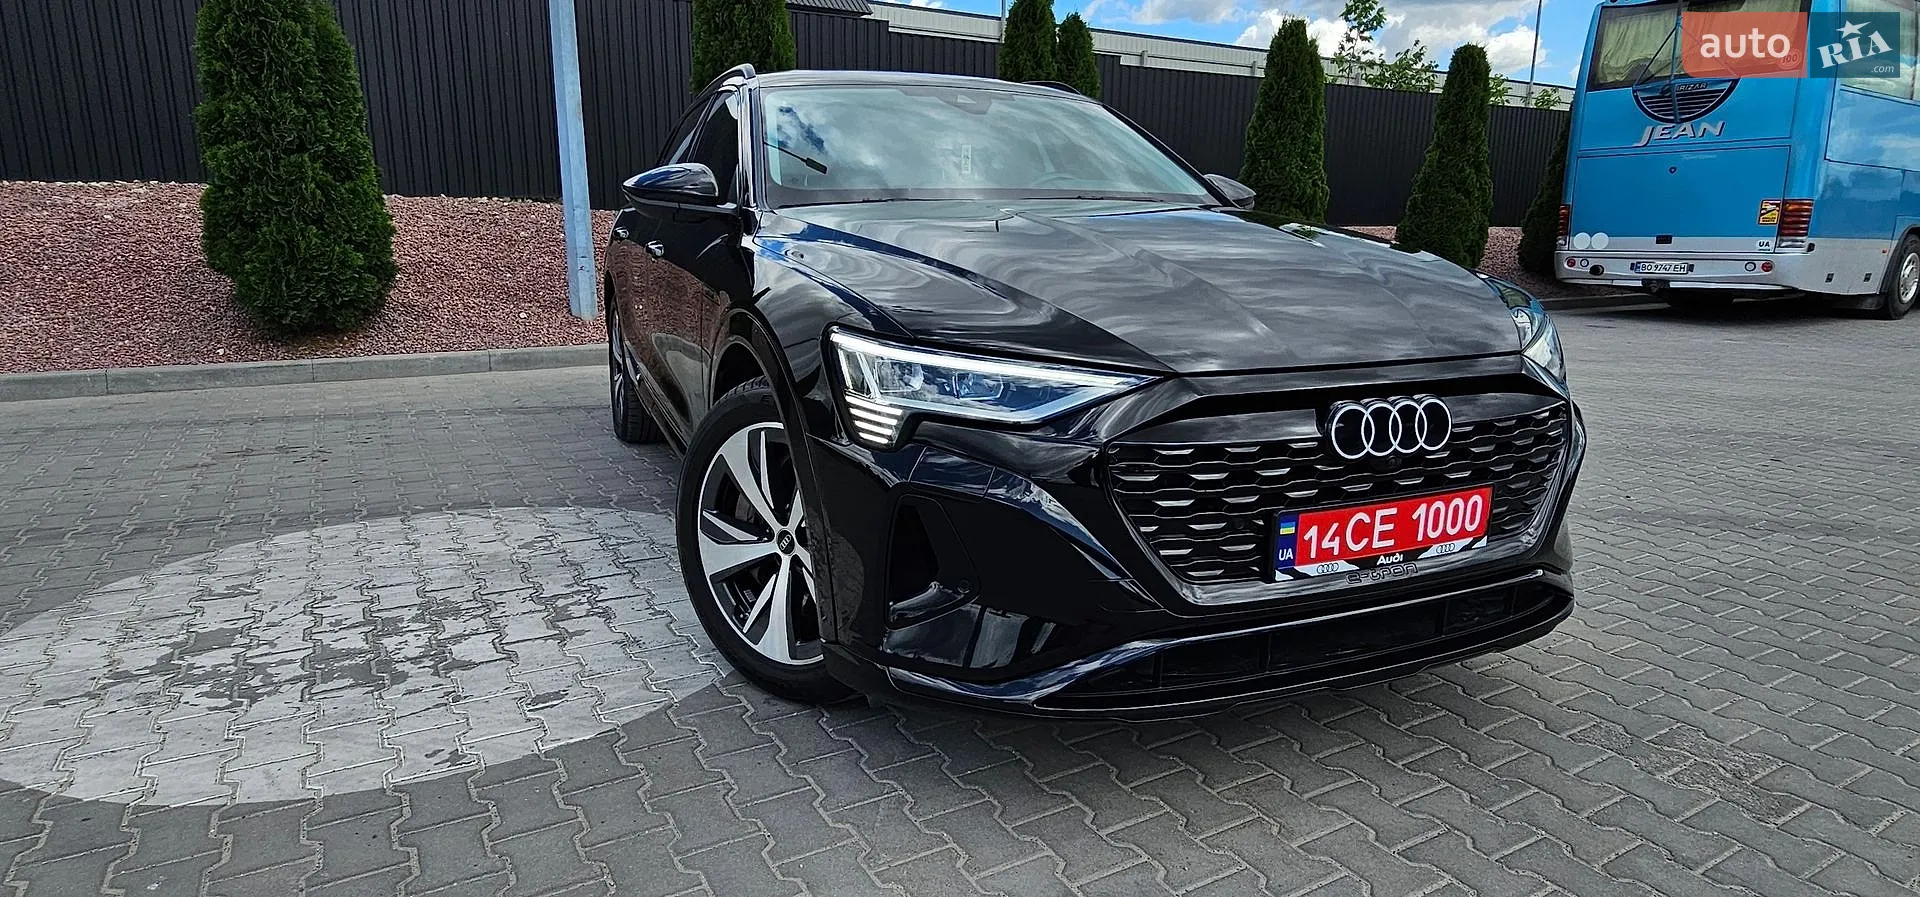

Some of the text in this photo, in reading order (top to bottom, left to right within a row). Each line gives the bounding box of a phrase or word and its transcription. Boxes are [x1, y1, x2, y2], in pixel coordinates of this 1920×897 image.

[1633, 121, 1726, 148] JEAN
[1758, 240, 1771, 248] UA
[1303, 494, 1484, 559] 14CE 1000
[1278, 549, 1294, 561] UA
[1376, 552, 1404, 566] Audi
[1346, 562, 1419, 585] e-tron
